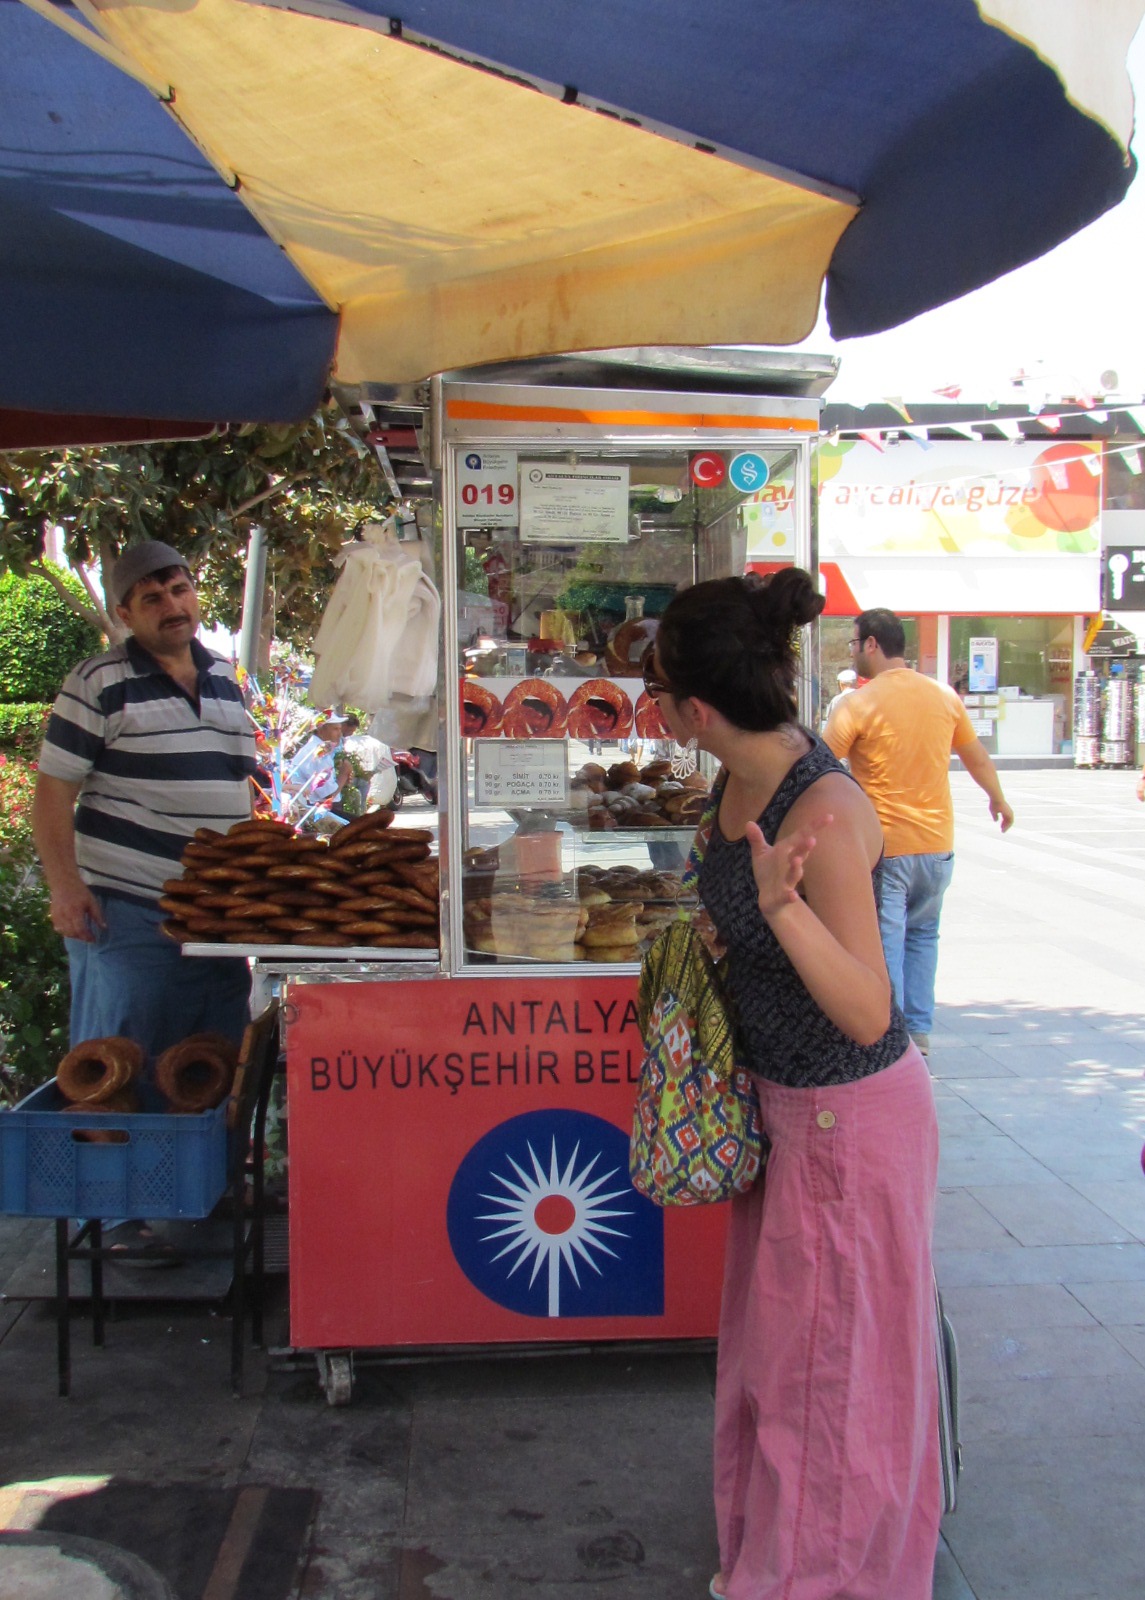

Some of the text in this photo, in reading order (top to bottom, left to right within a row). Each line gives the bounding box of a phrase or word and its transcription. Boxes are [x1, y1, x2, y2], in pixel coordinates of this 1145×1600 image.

[461, 484, 515, 506] 019
[506, 780, 535, 788] POĞAÇA
[512, 772, 530, 780] SİMİT
[462, 999, 639, 1036] ANTALYA
[310, 1045, 560, 1096] BÜYÜKŞEHİR
